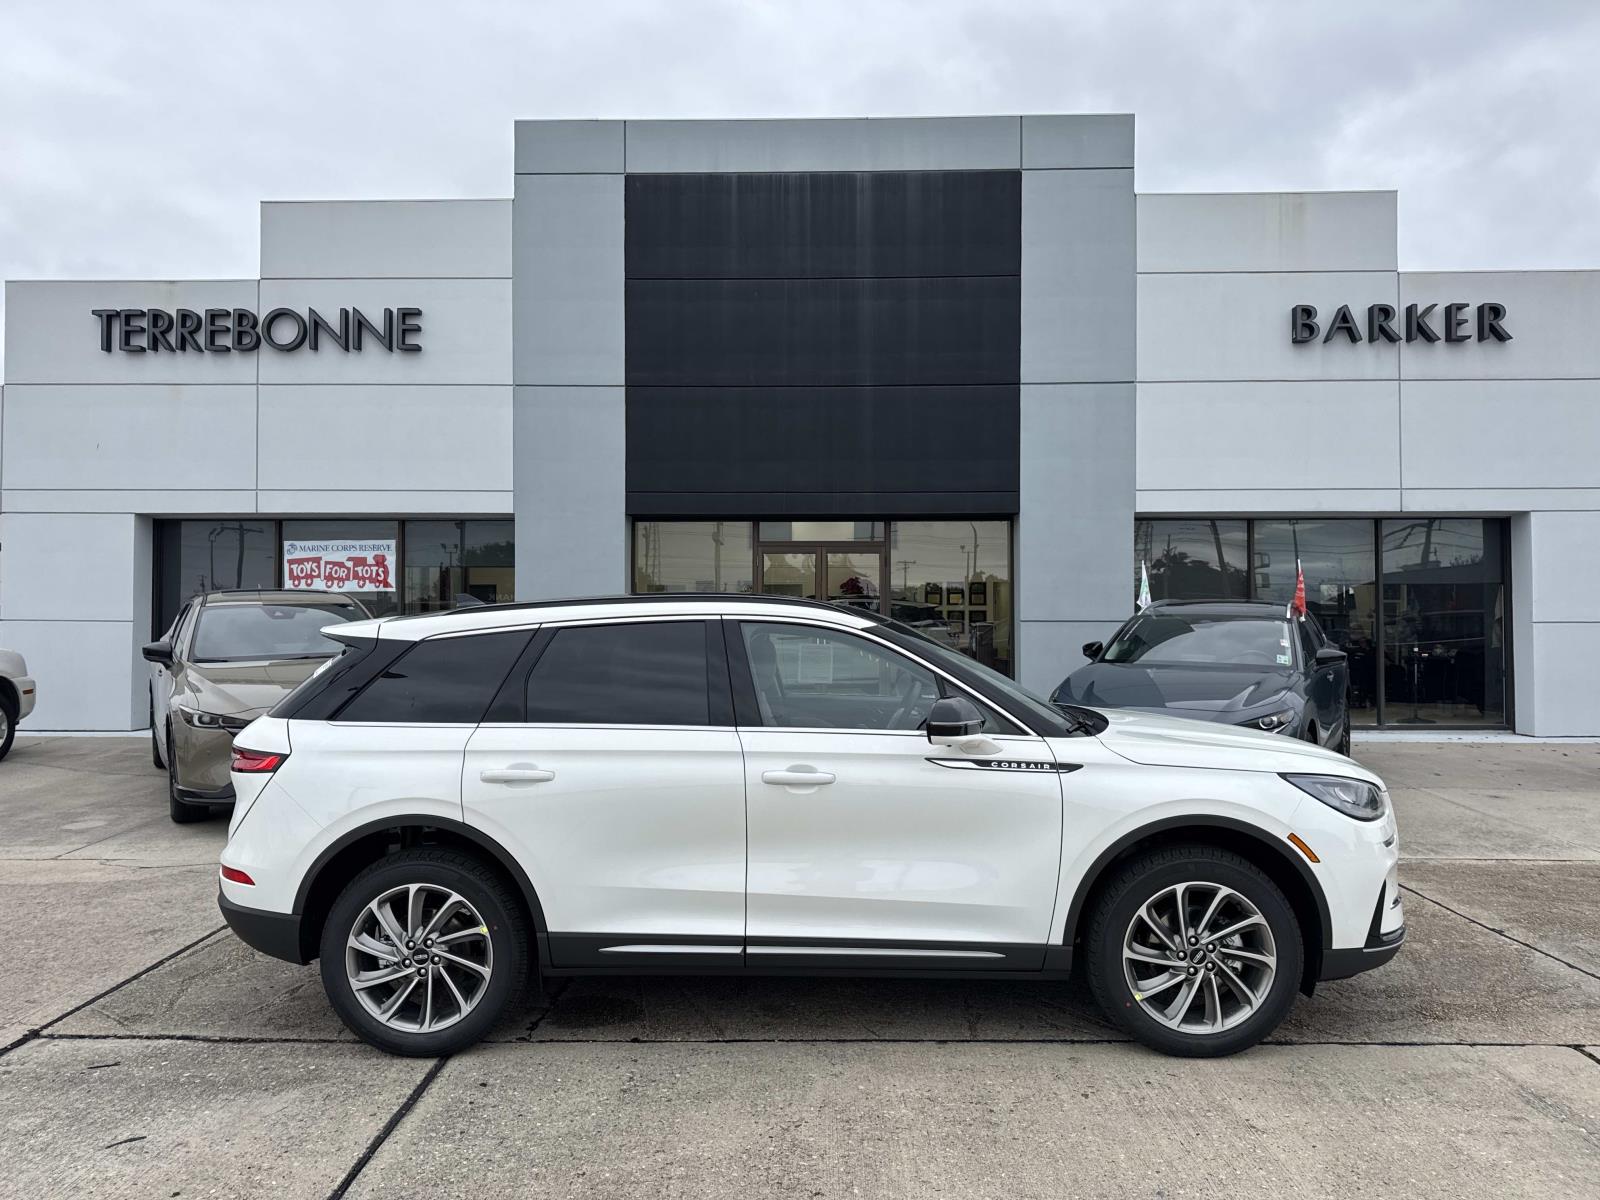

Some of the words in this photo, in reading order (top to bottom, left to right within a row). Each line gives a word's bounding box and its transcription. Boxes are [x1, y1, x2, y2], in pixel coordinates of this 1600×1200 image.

[91, 307, 422, 352] TERREBONNE
[1291, 303, 1513, 344] BARKER
[359, 544, 392, 552] RESERVE
[290, 561, 319, 577] TOYS
[325, 564, 347, 578] FOR
[354, 565, 385, 580] TOTS
[991, 761, 1050, 771] CORSAIR
